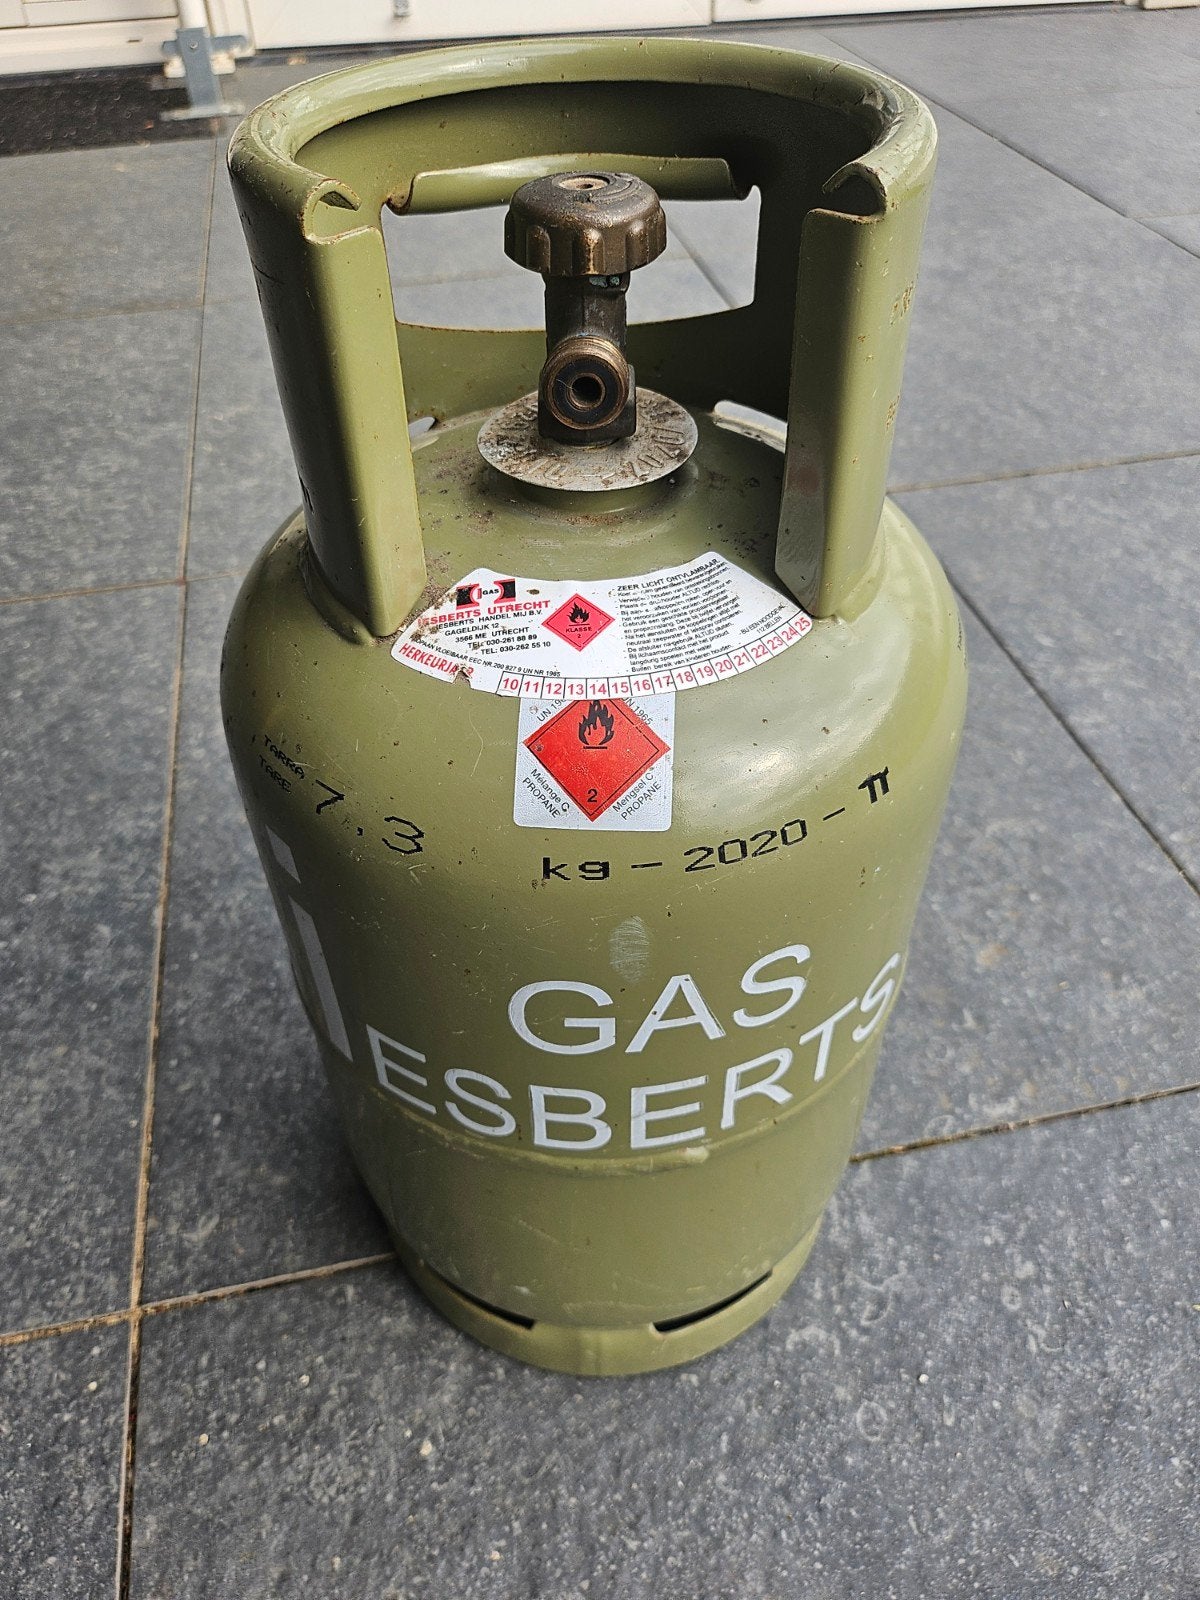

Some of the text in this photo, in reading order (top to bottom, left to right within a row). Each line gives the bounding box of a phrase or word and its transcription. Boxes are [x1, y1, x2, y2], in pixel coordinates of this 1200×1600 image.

[641, 578, 664, 588] LICHT
[487, 600, 550, 615] UTRECHT
[478, 613, 511, 624] HANDEL
[513, 610, 527, 618] MIJ
[528, 609, 543, 617] B.V.
[794, 617, 811, 631] 25
[444, 622, 500, 637] GAGELDIJK 12
[455, 626, 530, 643] 3566 ME UTRECHT
[781, 626, 797, 641] 24
[481, 647, 498, 655] TEL:
[499, 643, 529, 653] 030-262
[543, 640, 551, 648] 10
[767, 636, 784, 650] 23
[411, 638, 434, 649] OPAAN
[469, 656, 482, 665] EEC
[751, 644, 769, 659] 22
[398, 642, 475, 677] HERKEURJAR
[715, 659, 733, 674] 20
[733, 652, 751, 667] 21
[676, 670, 694, 684] 18
[696, 665, 714, 679] 19
[503, 677, 519, 690] 10
[523, 680, 540, 693] 11
[545, 682, 563, 695] 12
[589, 683, 607, 695] 14
[611, 681, 629, 694] 15
[633, 679, 651, 692] 16
[655, 675, 671, 688] 17
[567, 684, 584, 695] 13
[536, 708, 551, 722] UN
[634, 705, 653, 725] 1965
[264, 735, 305, 780] TARRA
[259, 754, 292, 793] TARE
[530, 768, 561, 804] Mélange
[522, 777, 561, 818] PROPANE
[587, 789, 598, 803] 2
[612, 779, 647, 812] Mengsel
[620, 781, 662, 820] PROPANE
[542, 856, 610, 881] kg
[683, 818, 808, 873] 2020
[508, 943, 811, 1056] GAS
